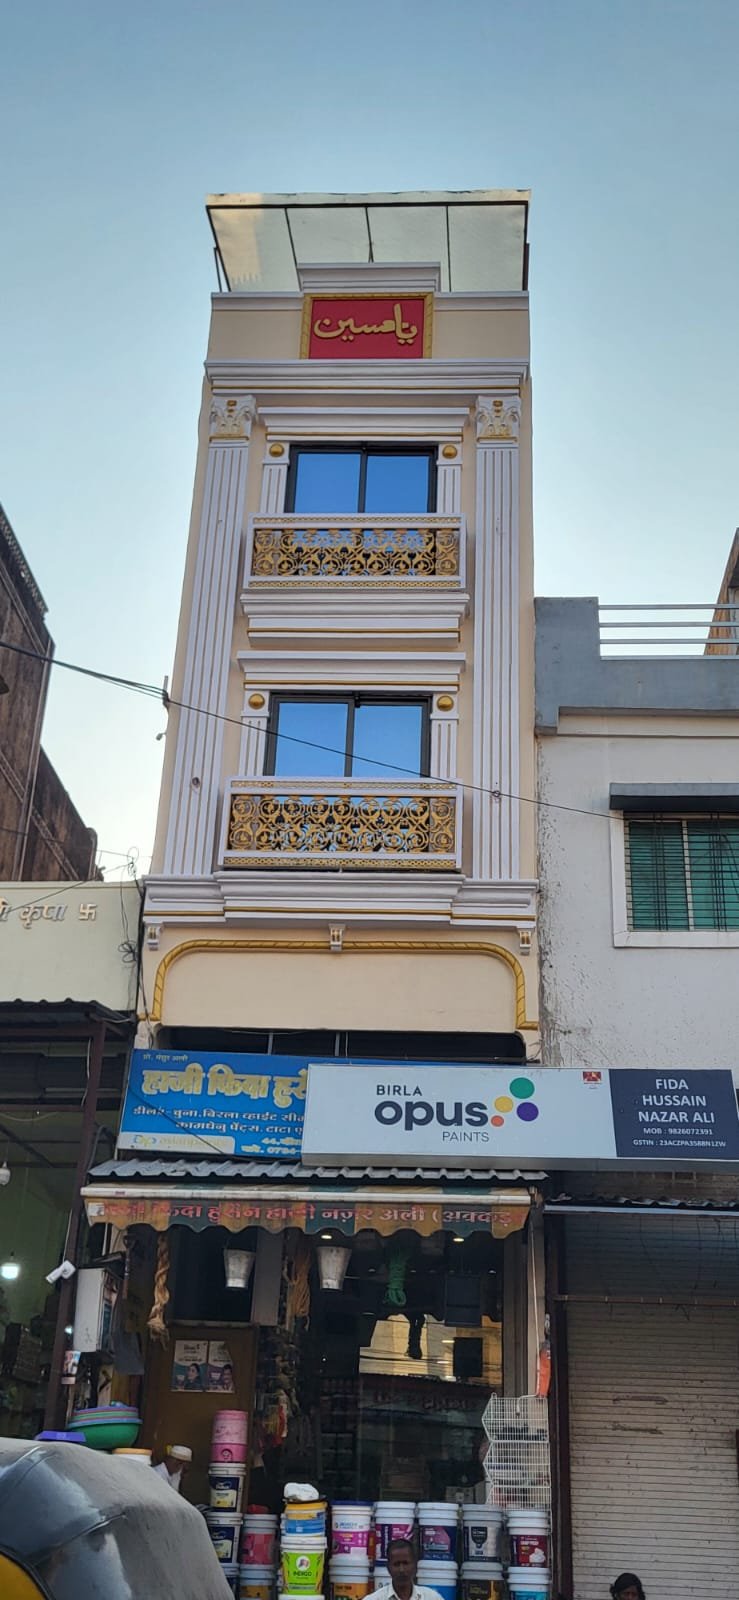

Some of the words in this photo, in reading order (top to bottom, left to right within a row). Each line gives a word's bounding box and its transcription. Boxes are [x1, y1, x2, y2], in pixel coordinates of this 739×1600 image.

[19, 904, 66, 929] कृपा
[142, 1063, 206, 1096] हाजी
[655, 1078, 689, 1090] FIDA
[376, 1084, 422, 1096] BIRLA
[642, 1094, 707, 1107] HUSSAIN
[374, 1100, 489, 1131] opus
[638, 1111, 689, 1123] NAZAR
[692, 1112, 715, 1123] ALI
[265, 1126, 291, 1134] टाटा
[643, 1127, 662, 1135] MOB
[668, 1128, 713, 1136] 9826072391
[442, 1131, 490, 1142] PAINTS
[379, 1204, 425, 1221] अली
